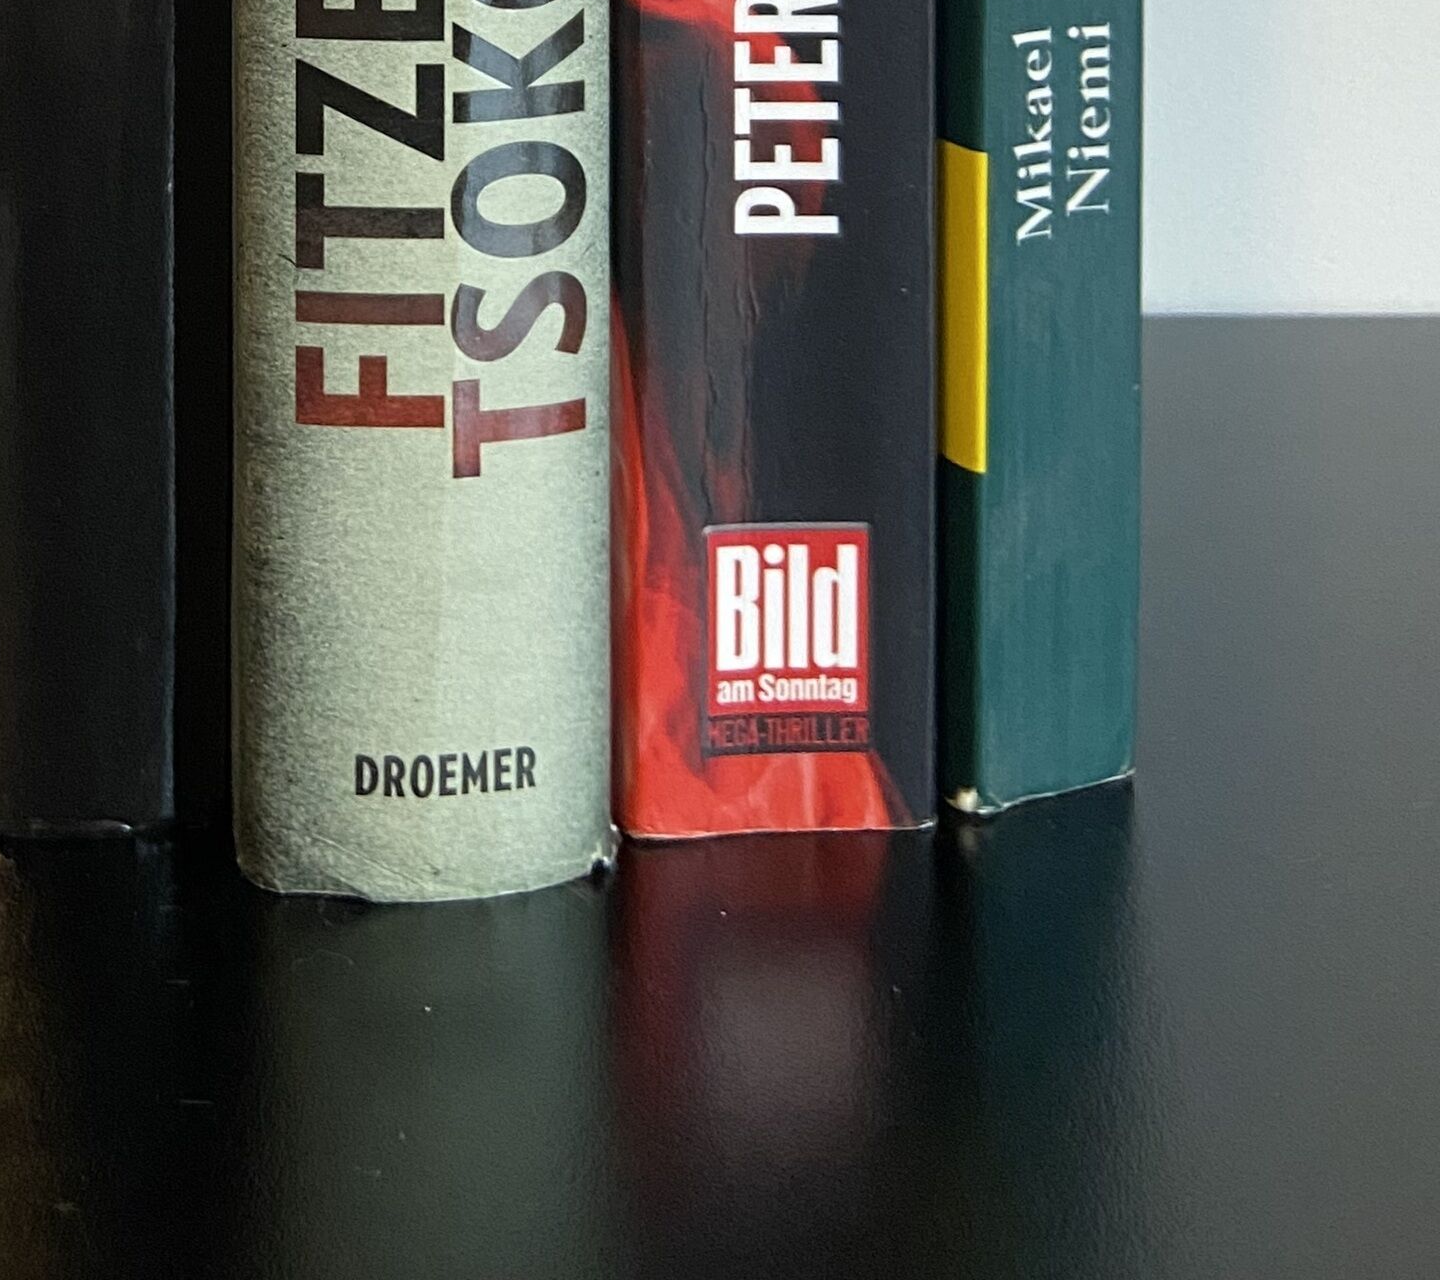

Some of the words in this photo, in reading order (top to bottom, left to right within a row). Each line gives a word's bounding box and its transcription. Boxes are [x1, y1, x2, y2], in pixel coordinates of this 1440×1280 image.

[1012, 26, 1053, 245] Mikael
[1066, 22, 1112, 216] Niemi
[716, 544, 858, 671] Bild
[717, 679, 755, 704] am
[759, 674, 858, 703] Sonntag
[354, 746, 537, 798] DROEMER
